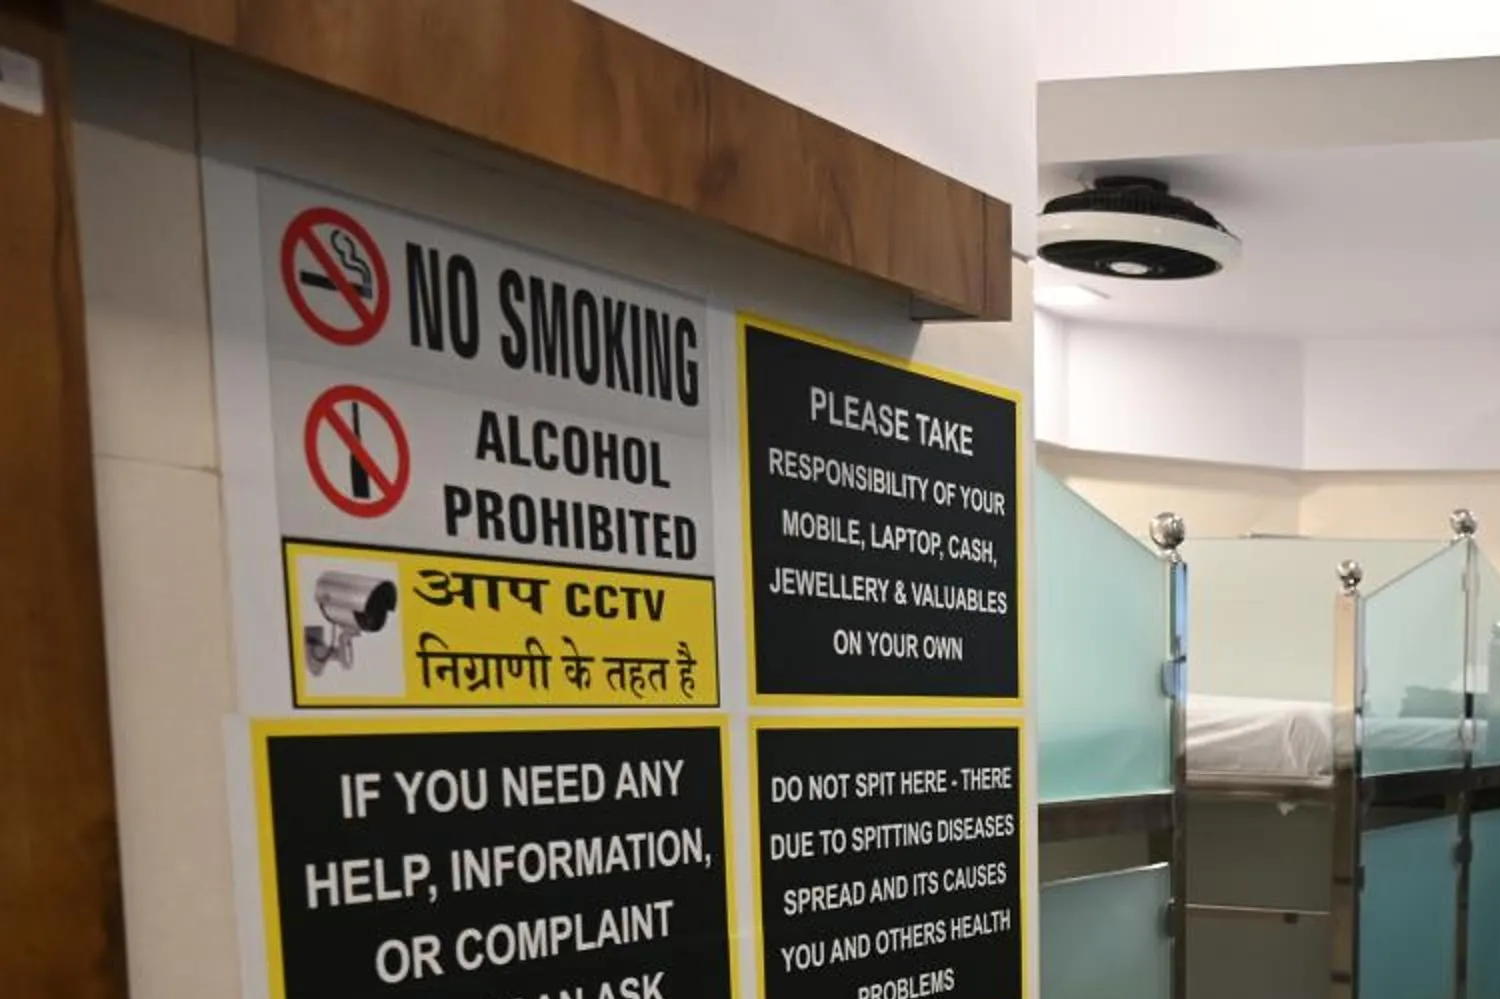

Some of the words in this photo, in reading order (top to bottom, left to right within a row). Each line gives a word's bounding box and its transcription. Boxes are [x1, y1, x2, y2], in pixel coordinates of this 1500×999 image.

[405, 240, 480, 360] NO
[498, 268, 700, 408] SMOKING
[475, 409, 671, 489] ALCOHOL
[810, 386, 910, 442] PLEASE
[915, 412, 974, 457] TAKE
[769, 447, 929, 502] RESPONSIBILITY
[933, 480, 957, 506] OF
[959, 485, 1005, 516] YOUR
[443, 484, 697, 561] PROHIBITED
[782, 508, 866, 551] MOBILE,
[870, 522, 945, 561] LAPTOP,
[947, 534, 997, 568] CASH,
[413, 569, 551, 615] आप
[565, 581, 665, 622] CCTV
[769, 567, 890, 603] JEWELLERY
[893, 579, 908, 605] &
[911, 581, 1008, 615] VALUABLES
[560, 635, 596, 691] के
[601, 656, 671, 699] तहत
[675, 641, 698, 699] है
[833, 628, 863, 656] ON
[866, 631, 919, 659] YOUR
[922, 635, 963, 661] OWN
[340, 772, 381, 819] IF
[393, 767, 488, 815] YOU
[501, 763, 606, 808] NEED
[614, 759, 685, 801] ANY
[771, 775, 803, 803] DO
[808, 773, 851, 801] NOT
[855, 771, 897, 798] SPIT
[900, 769, 948, 795] HERE
[960, 766, 1012, 791] THERE
[305, 853, 438, 909] HELP,
[451, 827, 711, 892] INFORMATION,
[770, 831, 815, 861] DUE
[818, 828, 847, 855] TO
[851, 820, 933, 852] SPITTING
[937, 813, 1015, 843] DISEASES
[783, 880, 866, 916] SPREAD
[869, 875, 909, 904] AND
[912, 870, 939, 897] ITS
[942, 861, 1007, 892] CAUSES
[375, 934, 444, 984] OR
[455, 899, 674, 971] COMPLAINT
[780, 941, 825, 973] YOU
[829, 933, 871, 964] AND
[875, 919, 947, 955] OTHERS
[950, 908, 1011, 941] HEALTH
